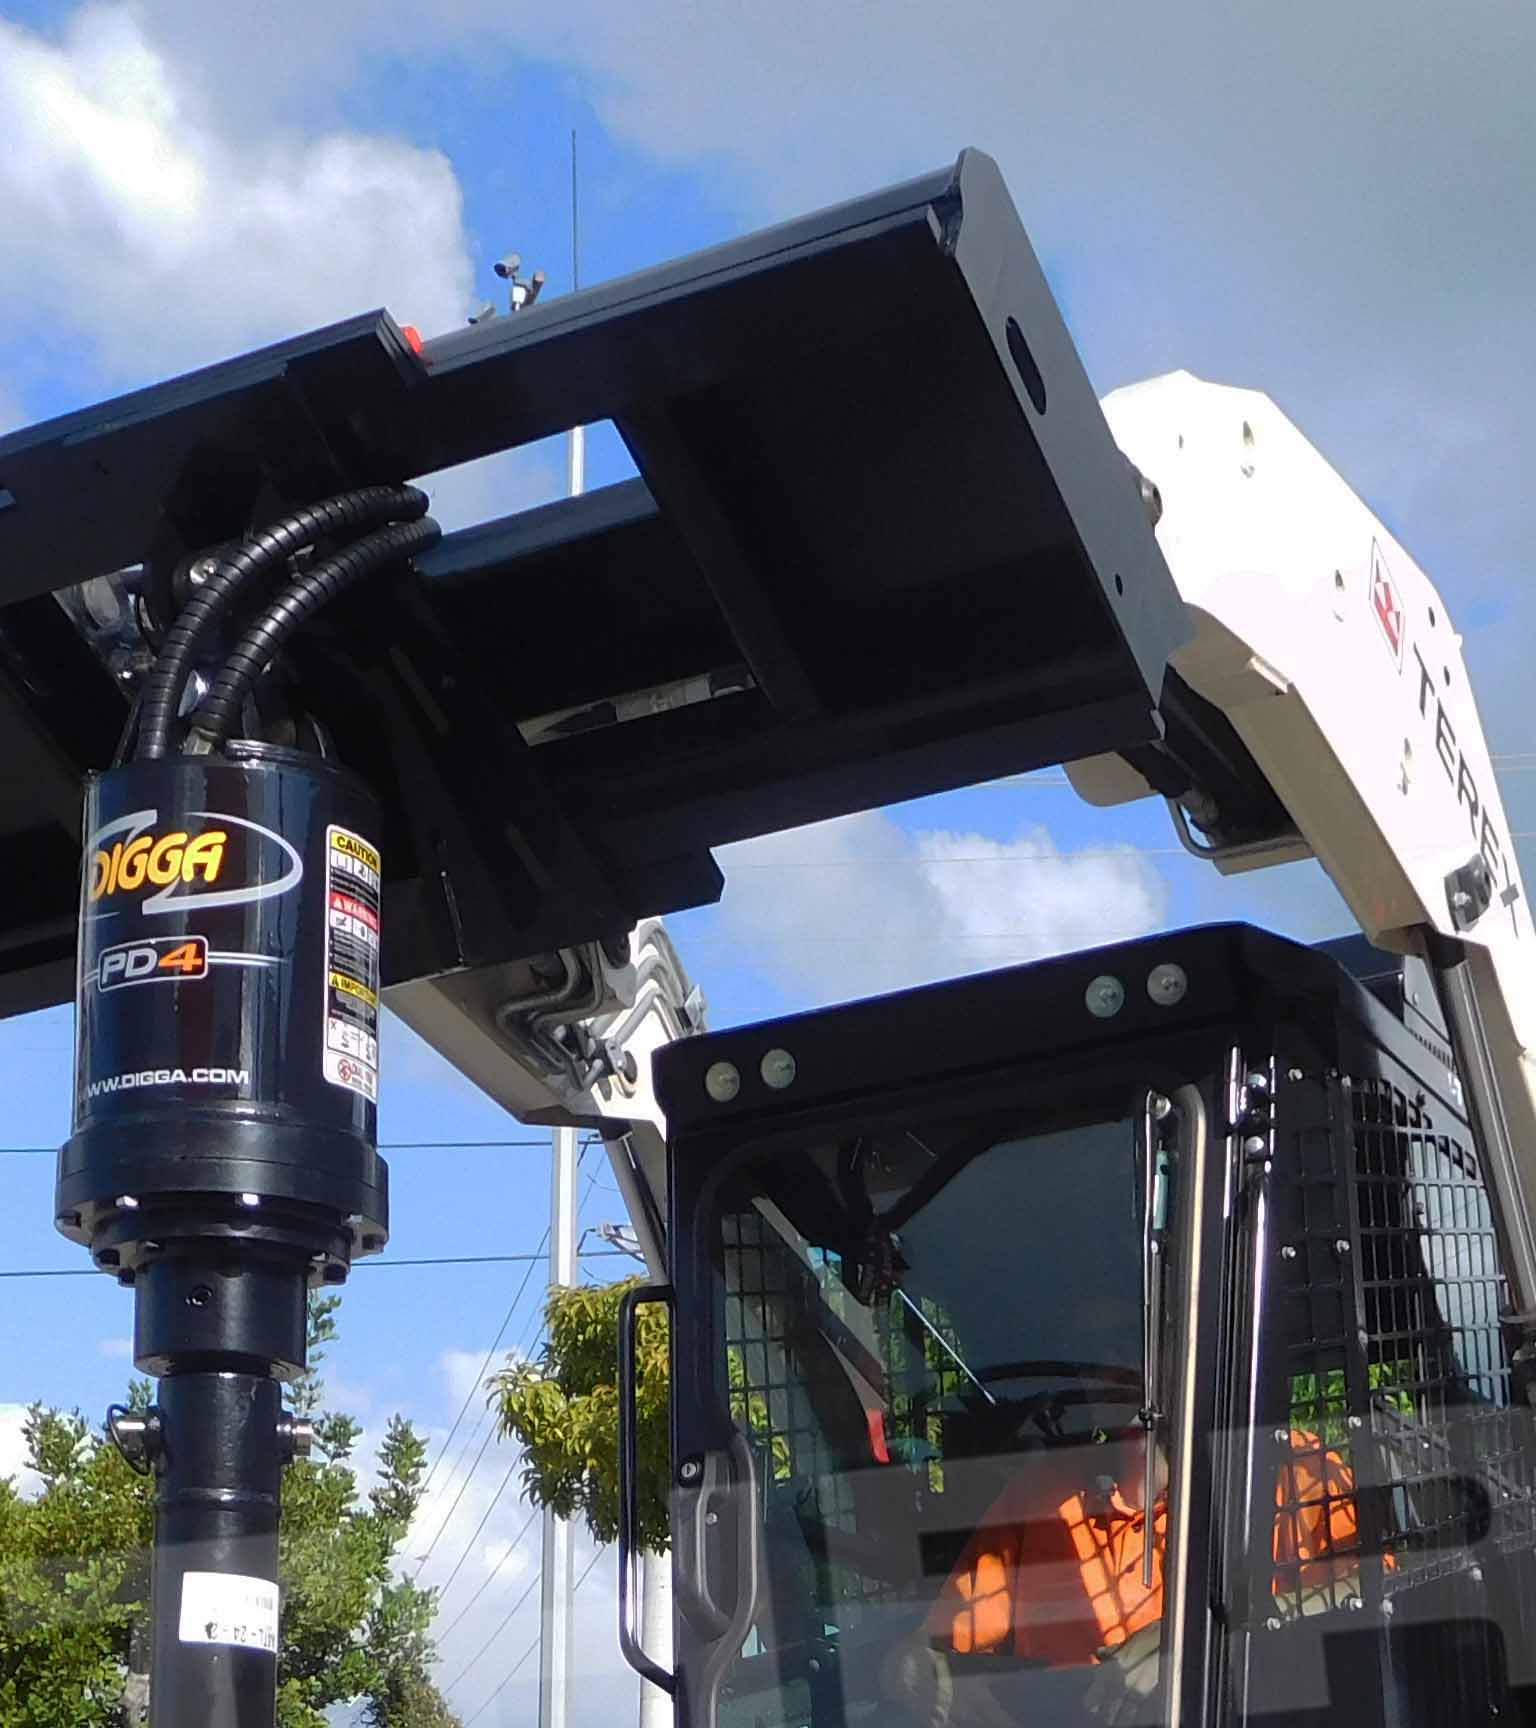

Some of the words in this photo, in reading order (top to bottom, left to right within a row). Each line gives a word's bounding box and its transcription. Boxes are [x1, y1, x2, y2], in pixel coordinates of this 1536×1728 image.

[1413, 642, 1520, 939] TEREX
[90, 831, 227, 900] DIGGA
[101, 943, 203, 984] PD4
[87, 1068, 249, 1098] WW.DIGGA.COM
